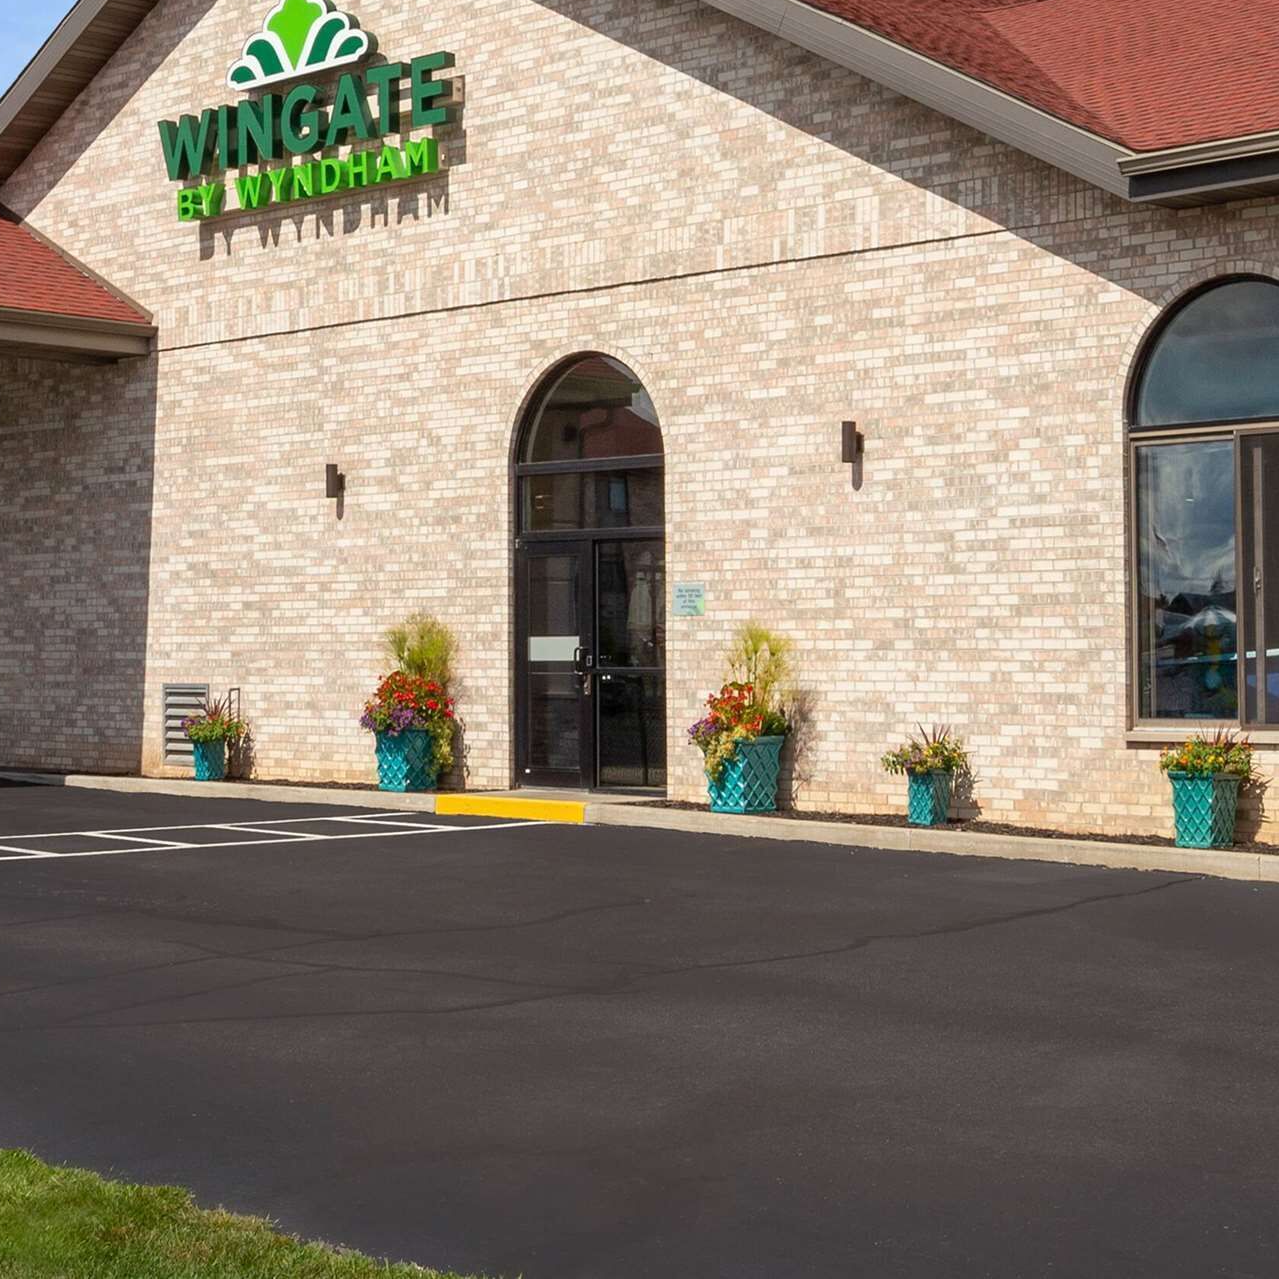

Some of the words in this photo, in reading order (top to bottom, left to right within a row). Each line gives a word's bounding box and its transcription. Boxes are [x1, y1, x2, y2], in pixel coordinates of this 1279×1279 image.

[158, 51, 455, 181] WINGATE
[177, 183, 225, 221] BY
[235, 137, 438, 209] WYNDHAM
